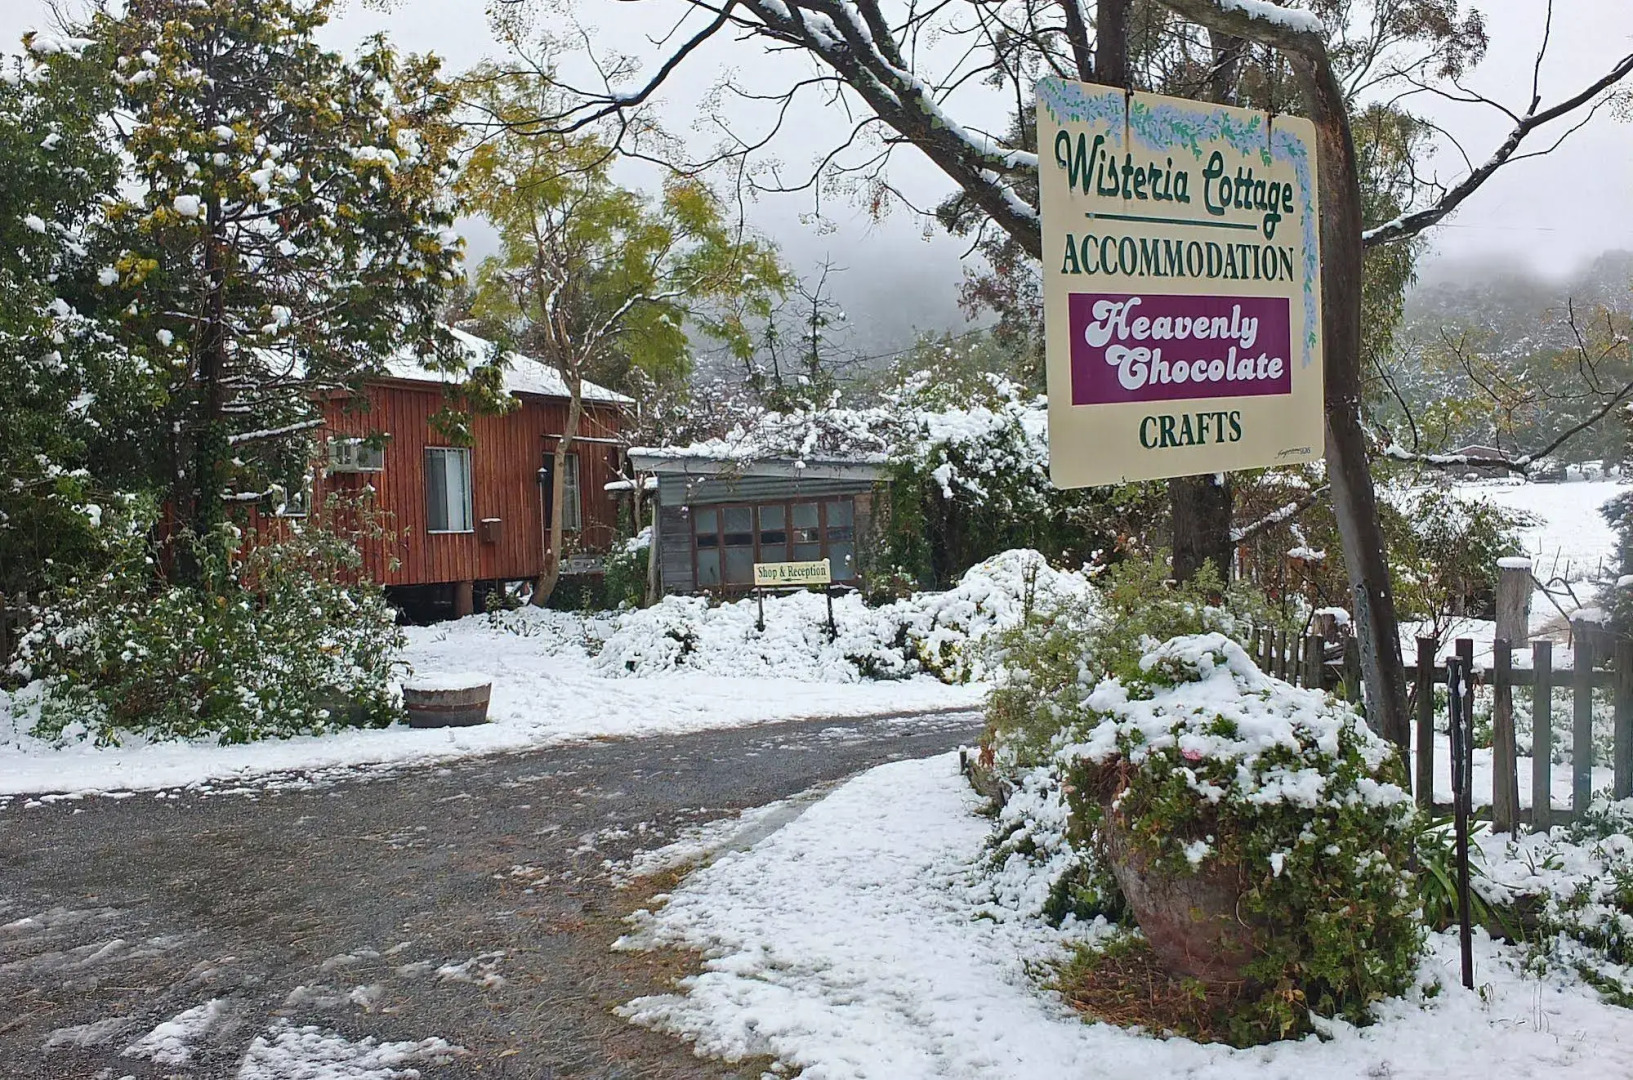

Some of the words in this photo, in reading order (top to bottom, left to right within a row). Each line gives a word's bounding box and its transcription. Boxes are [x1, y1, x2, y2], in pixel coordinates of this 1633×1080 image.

[1054, 130, 1190, 204] Wisteria
[1202, 151, 1294, 240] Cottage
[1061, 234, 1294, 282] ACCOMMODATION
[1084, 297, 1259, 349] Heavenly
[1105, 344, 1284, 390] Chocolate
[1139, 411, 1242, 449] CRAFTS
[758, 566, 777, 579] Shop
[780, 565, 785, 577] &
[787, 564, 826, 579] Reception
